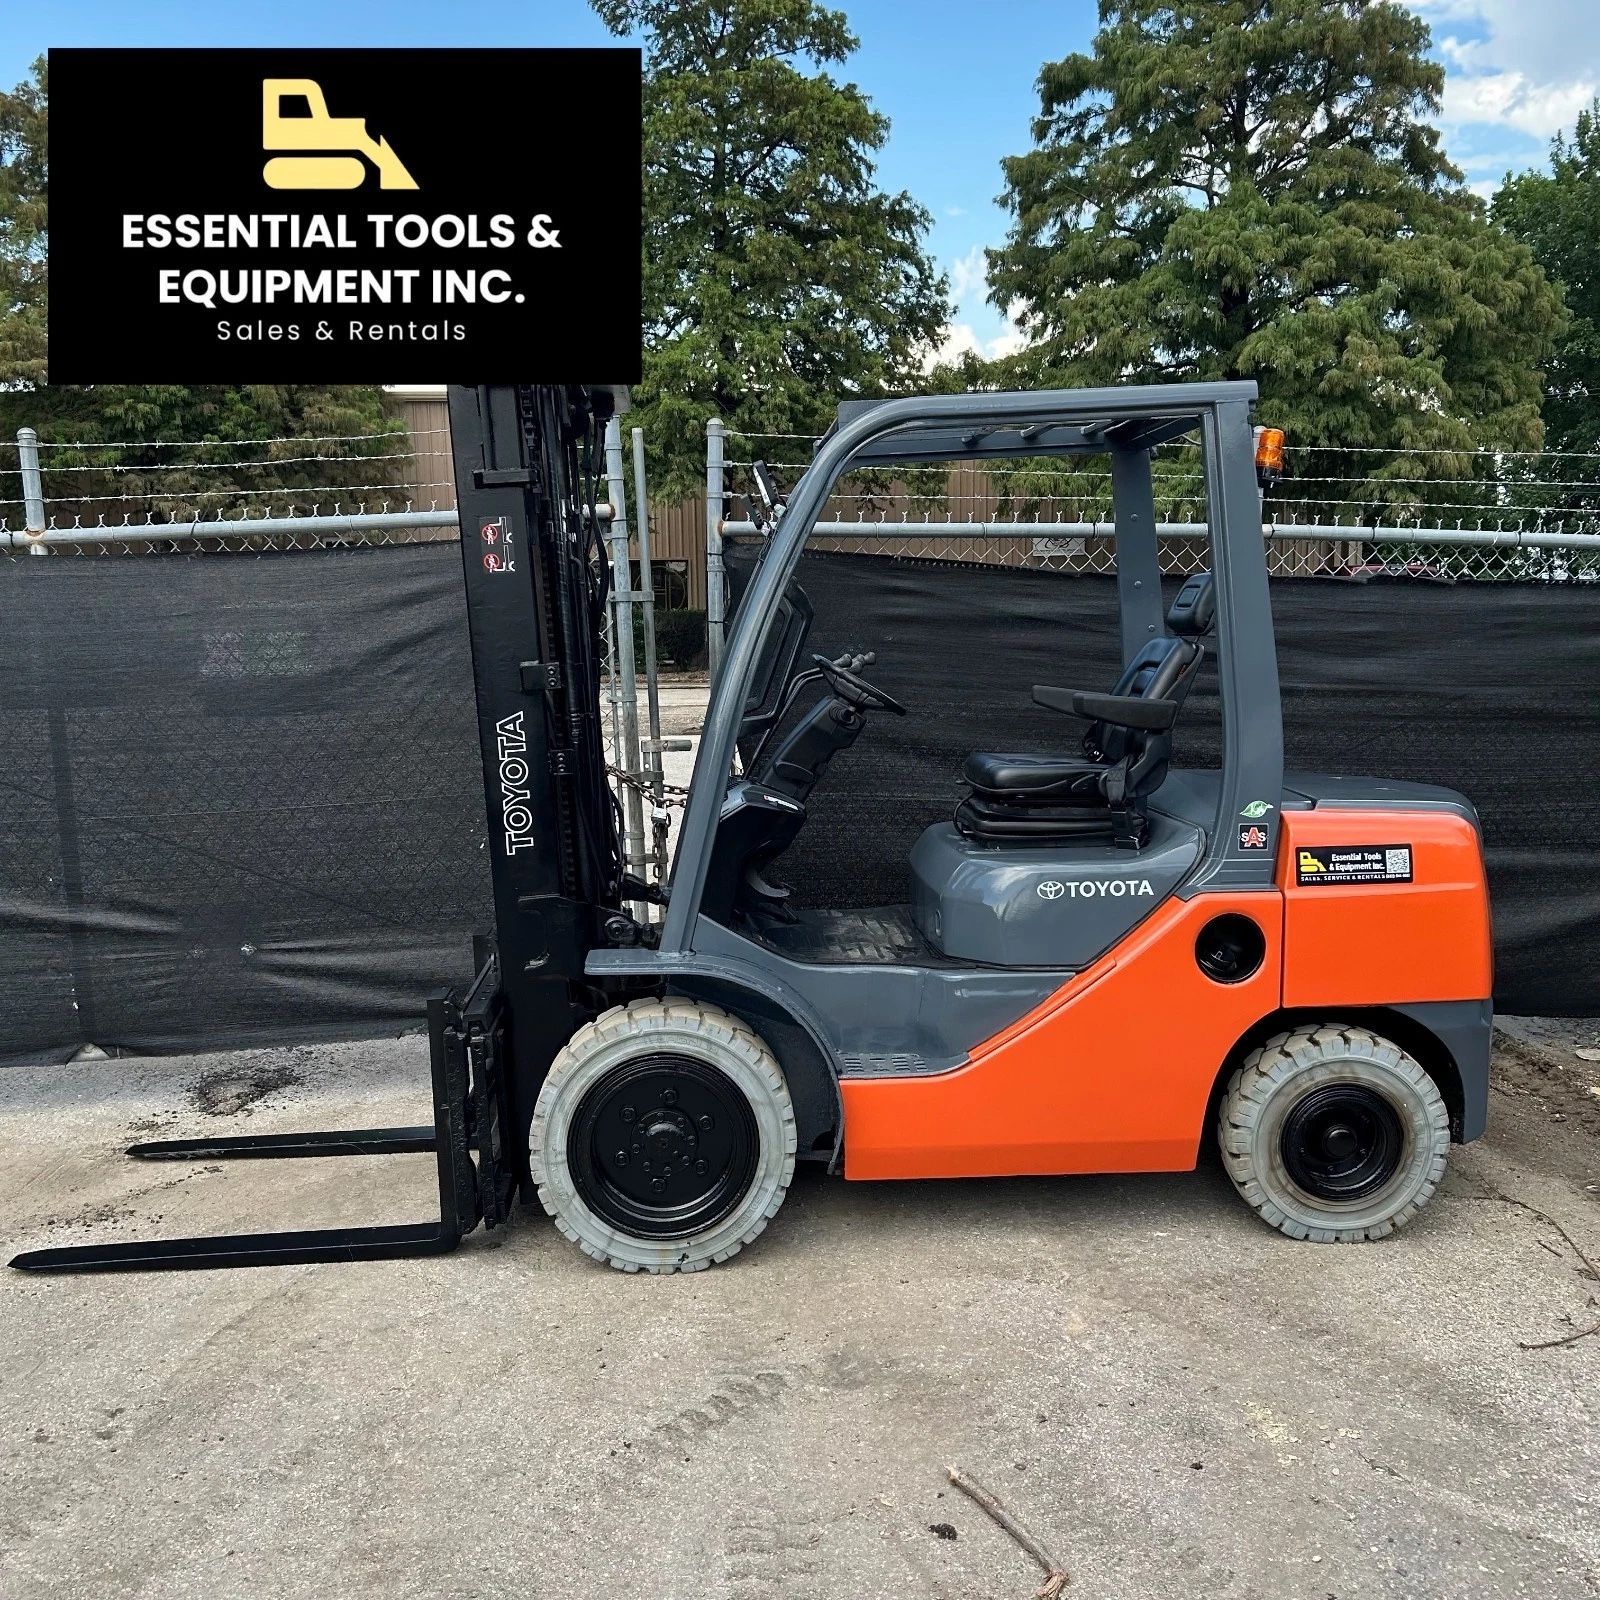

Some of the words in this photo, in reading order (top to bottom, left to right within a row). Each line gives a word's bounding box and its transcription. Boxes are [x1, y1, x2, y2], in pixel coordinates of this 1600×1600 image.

[496, 711, 534, 855] TOYOTA
[1241, 827, 1267, 848] SAS
[1331, 852, 1362, 861] Essential
[1364, 852, 1382, 860] Tools
[1335, 862, 1373, 872] Equipment
[1066, 880, 1154, 897] TOYOTA
